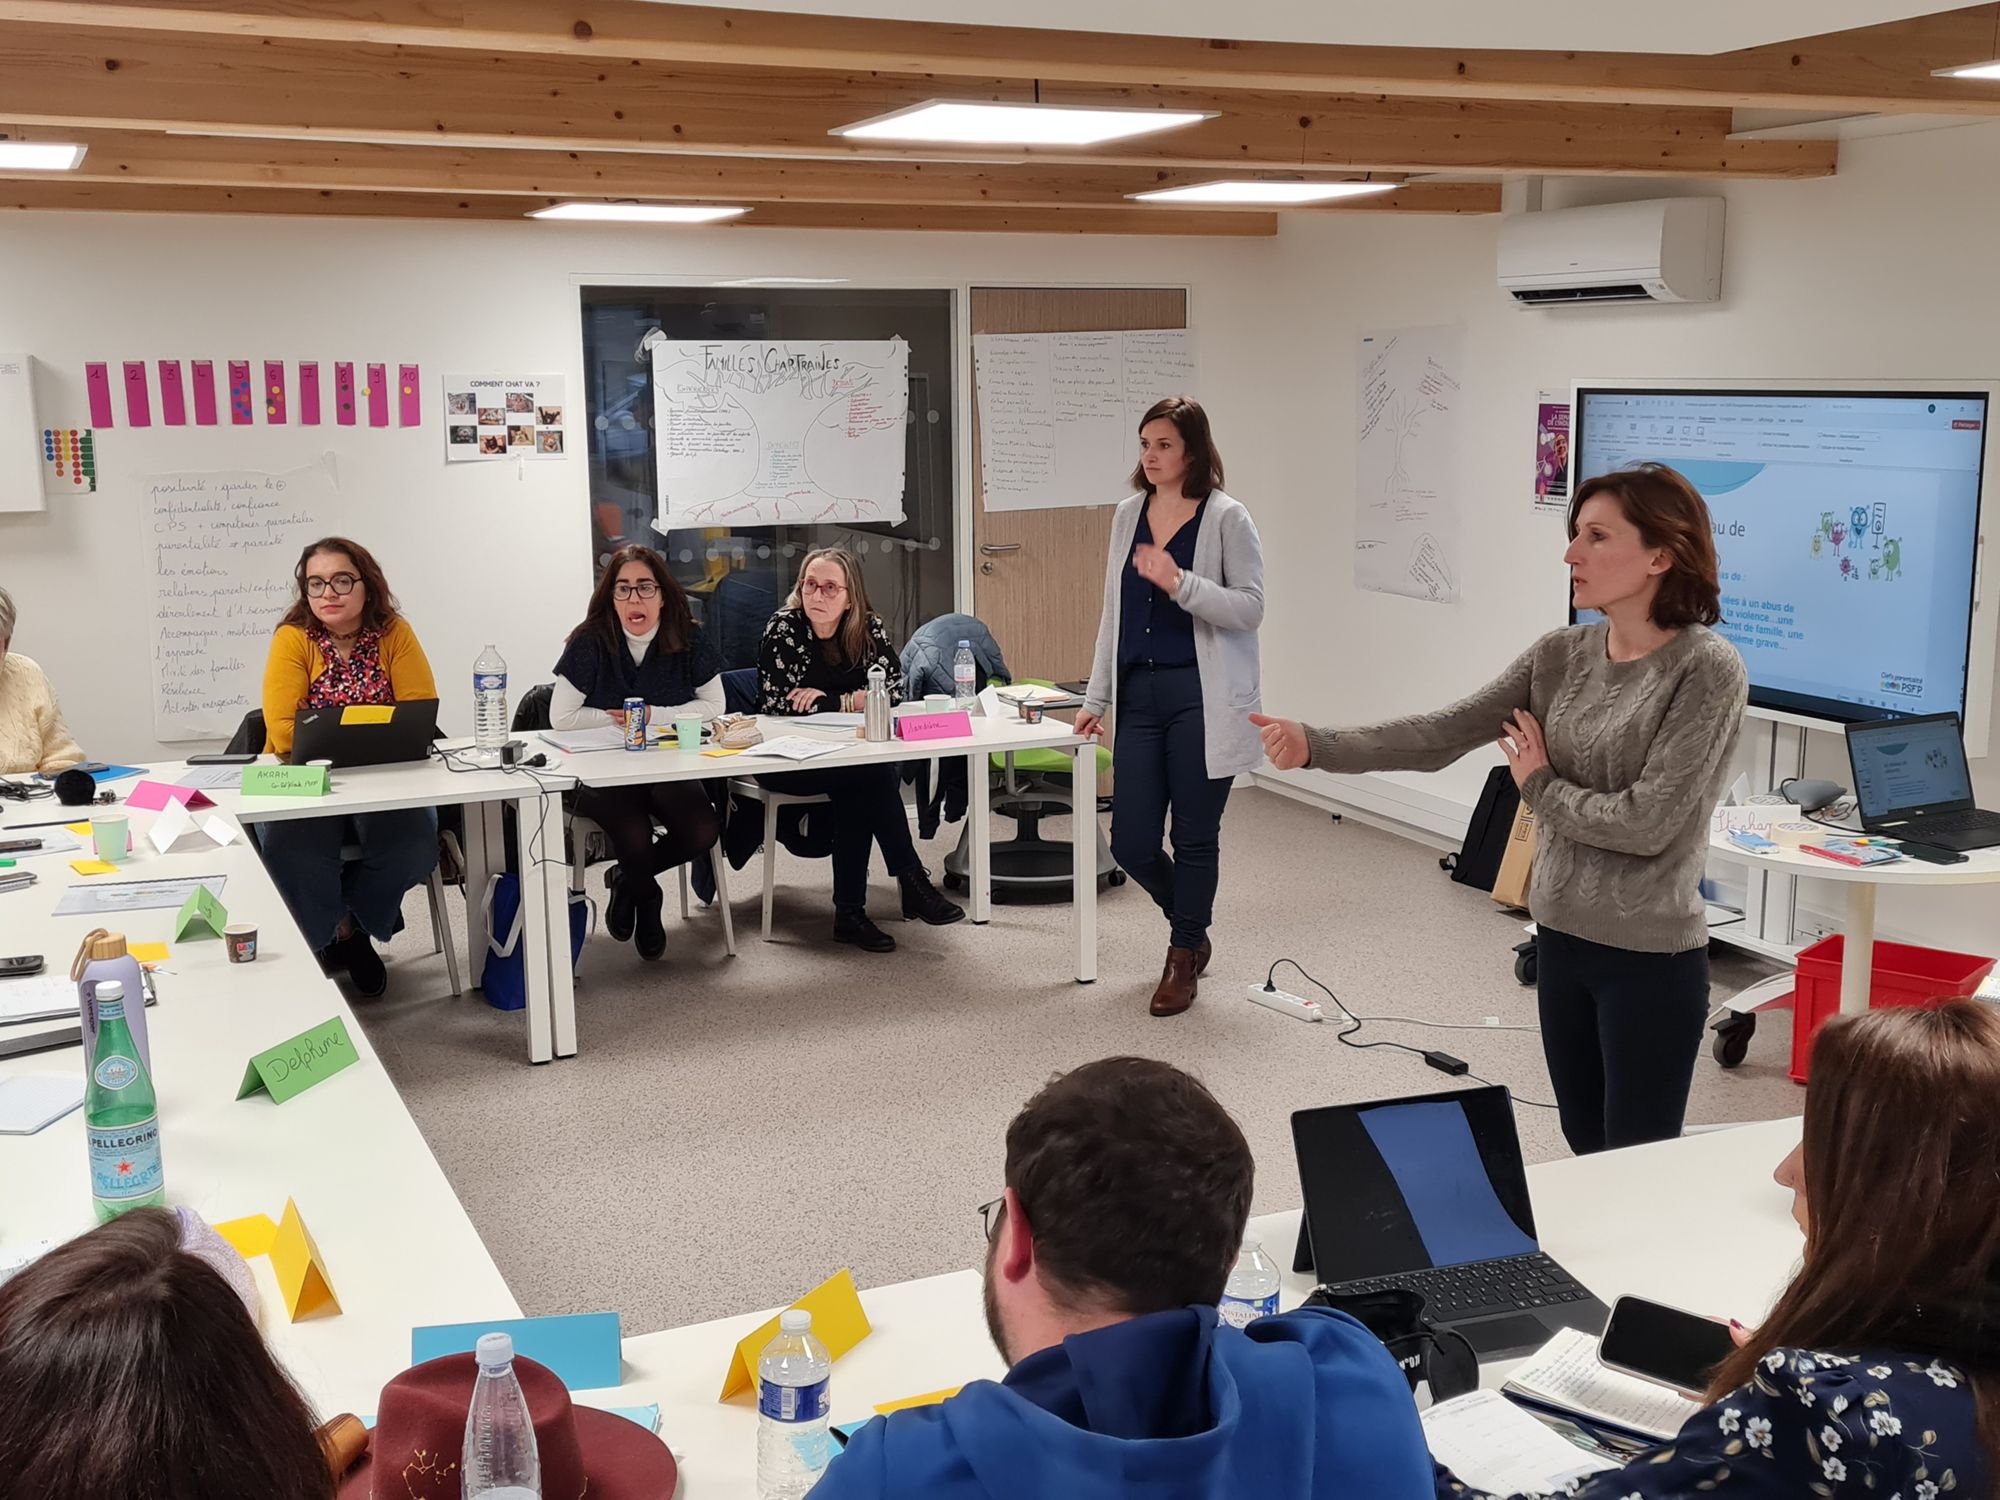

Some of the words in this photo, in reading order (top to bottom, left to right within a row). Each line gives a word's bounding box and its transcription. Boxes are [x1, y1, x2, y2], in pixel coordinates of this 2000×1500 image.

[90, 369, 100, 379] 1
[129, 369, 140, 381] 2
[166, 368, 175, 381] 3
[234, 367, 244, 380] 5
[269, 369, 277, 380] 6
[302, 368, 313, 381] 7
[339, 369, 348, 383] 8
[374, 370, 381, 384] 9
[402, 371, 416, 382] 10
[470, 380, 504, 388] COMMENT
[505, 380, 523, 388] CHAT
[525, 380, 534, 388] VA
[231, 497, 281, 517] confiance
[1728, 520, 1746, 537] de
[180, 561, 229, 576] émotions
[1741, 597, 1748, 607] à
[1748, 600, 1760, 609] un
[1761, 599, 1782, 612] abus
[1784, 601, 1795, 613] de
[1743, 623, 1754, 633] de
[1755, 623, 1785, 638] famille,
[1787, 630, 1805, 641] une
[210, 656, 246, 682] familles
[256, 770, 289, 779] AKRAM
[266, 1032, 345, 1083] Delphine
